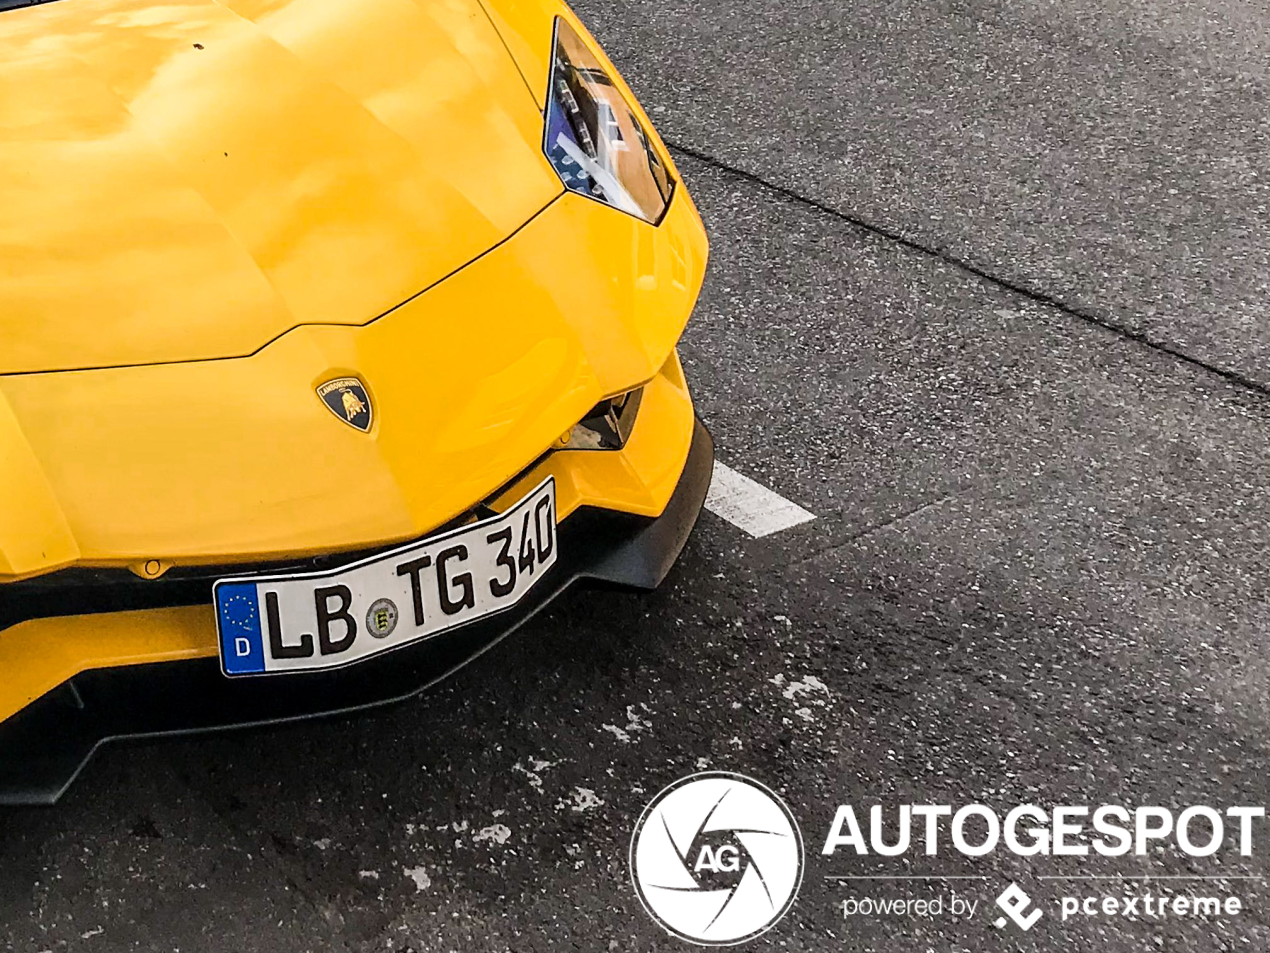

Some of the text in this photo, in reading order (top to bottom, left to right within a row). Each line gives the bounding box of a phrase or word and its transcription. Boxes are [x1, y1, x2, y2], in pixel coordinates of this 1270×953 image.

[265, 494, 553, 659] LB TG 340
[235, 637, 251, 657] D
